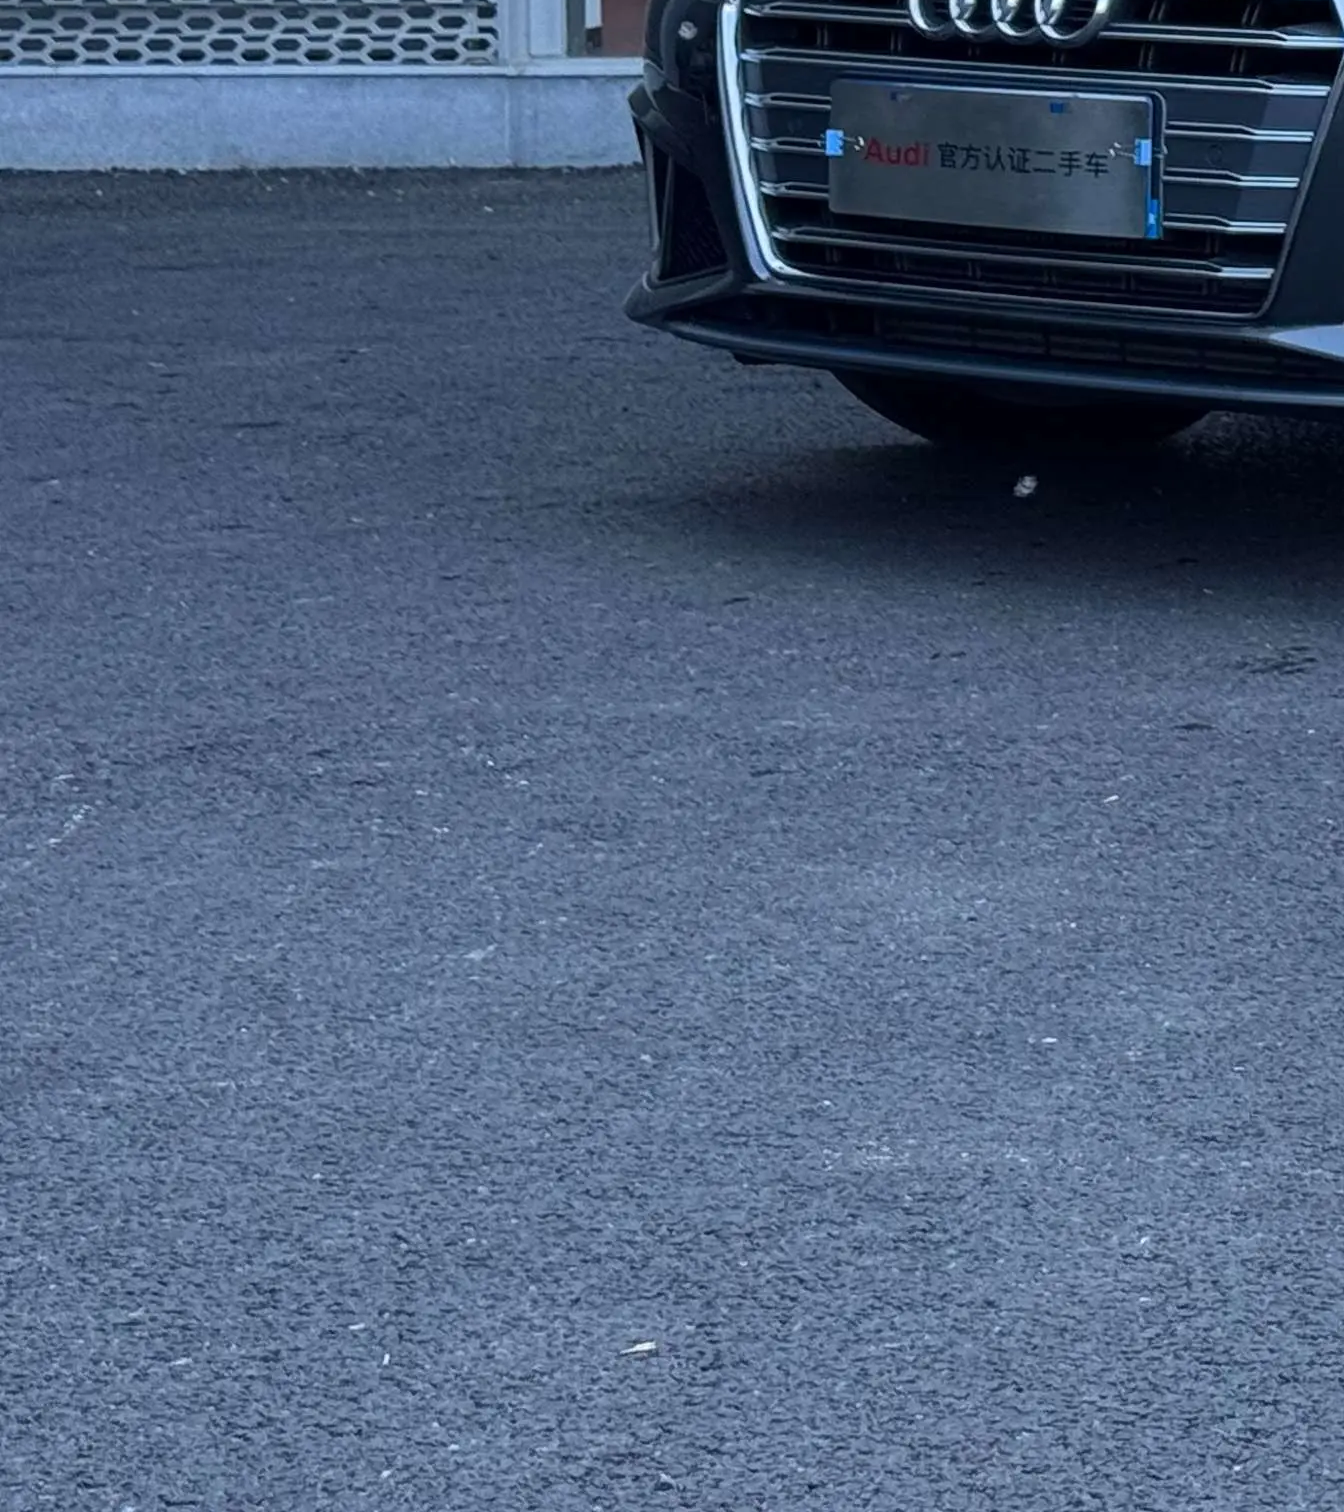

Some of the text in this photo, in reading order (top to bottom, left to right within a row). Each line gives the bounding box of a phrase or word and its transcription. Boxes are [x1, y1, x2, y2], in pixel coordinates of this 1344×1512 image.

[864, 138, 1109, 178] Audi 官方认证二手车
